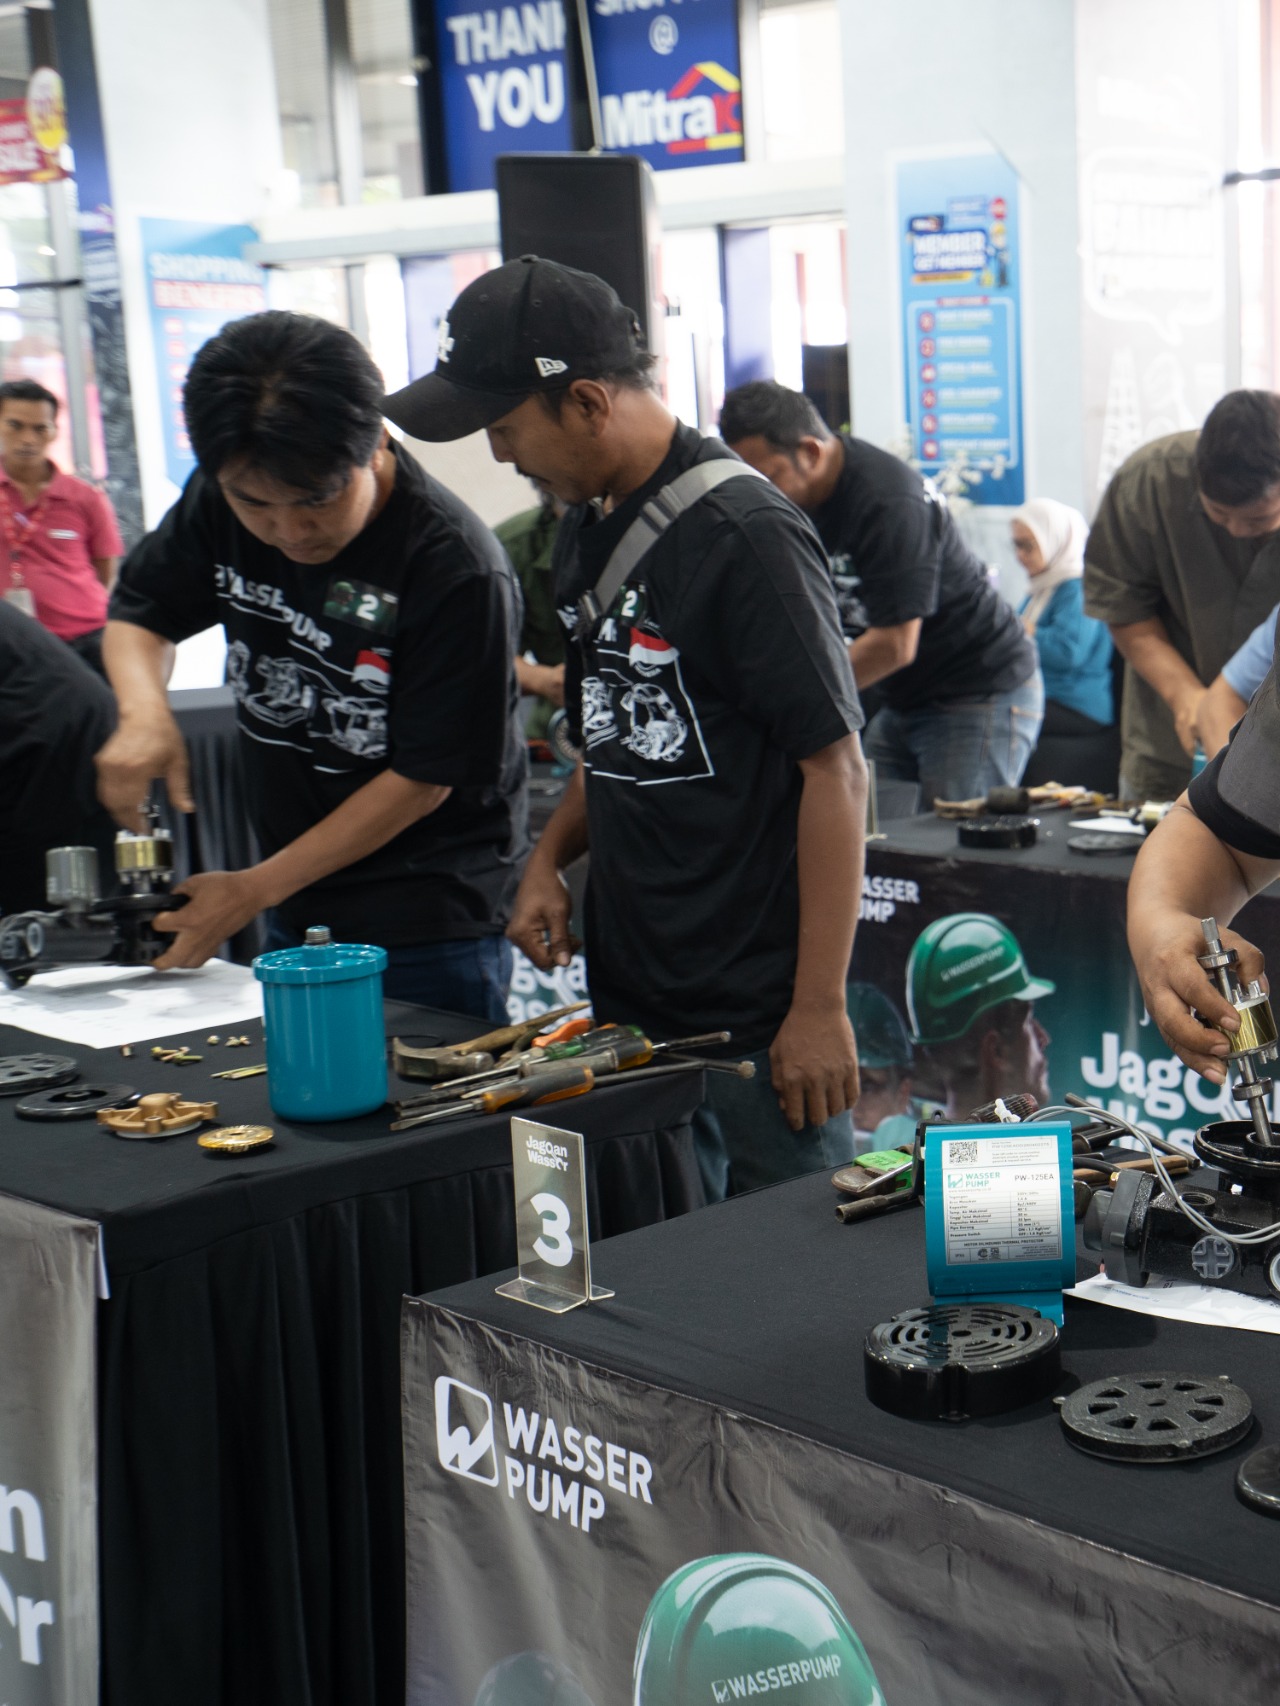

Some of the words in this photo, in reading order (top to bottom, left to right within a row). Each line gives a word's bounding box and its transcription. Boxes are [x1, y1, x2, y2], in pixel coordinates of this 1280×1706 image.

[447, 2, 567, 65] THAN
[466, 61, 565, 132] YOU
[355, 594, 379, 622] 2
[620, 590, 638, 617] 2
[860, 875, 921, 903] ASSER
[965, 1172, 1000, 1180] WASSER
[965, 1180, 990, 1188] PUMP
[1014, 1174, 1054, 1182] PW-125EA
[530, 1192, 574, 1267] 3
[503, 1402, 653, 1505] WASSER
[505, 1455, 605, 1533] PUMP
[727, 1653, 842, 1699] WASSERPUMP
